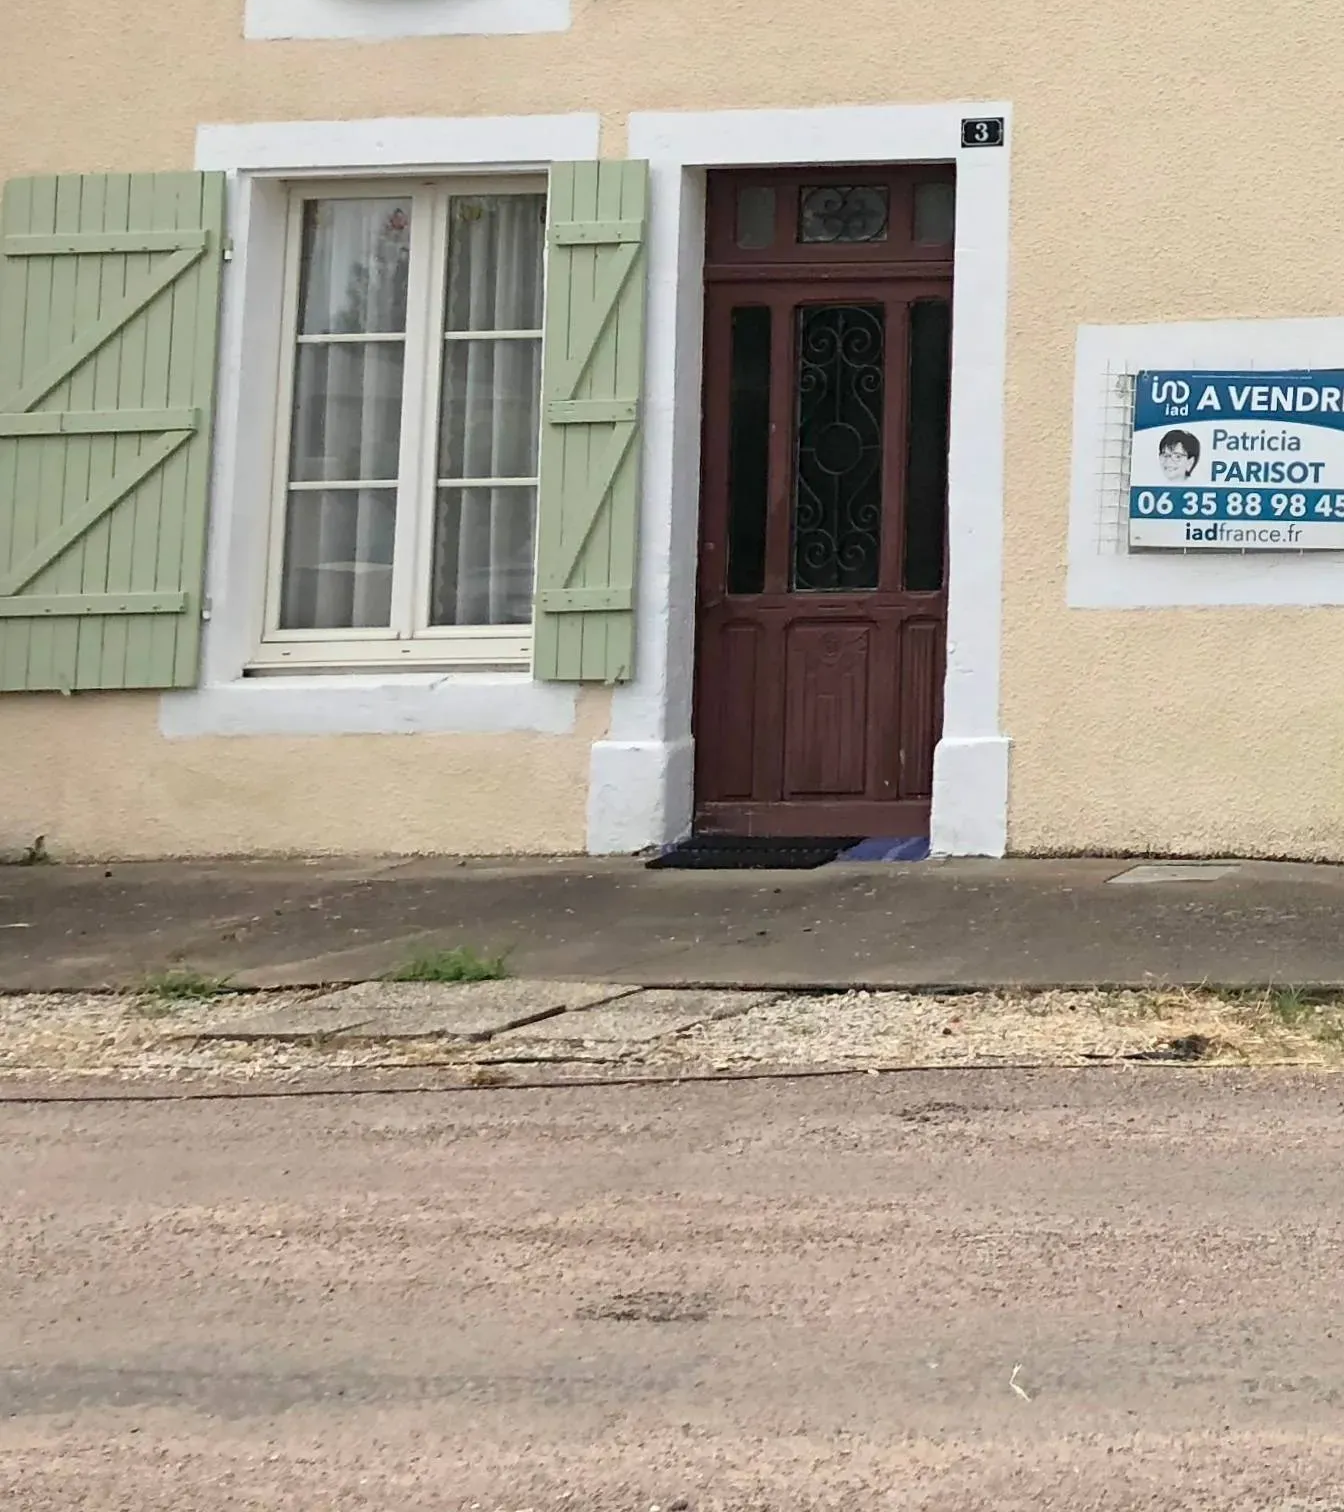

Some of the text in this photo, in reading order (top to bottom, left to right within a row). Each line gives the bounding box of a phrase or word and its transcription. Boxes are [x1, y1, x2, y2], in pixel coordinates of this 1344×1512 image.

[974, 122, 989, 142] 3
[1165, 403, 1189, 417] iad
[1196, 385, 1222, 411] A
[1212, 428, 1301, 452] Patricia
[1210, 460, 1326, 484] PARISOT
[1137, 491, 1174, 515] 06
[1181, 491, 1217, 516] 35
[1226, 492, 1262, 517] 88
[1270, 493, 1307, 517] 98
[1185, 522, 1303, 543] iadfrance.fr
